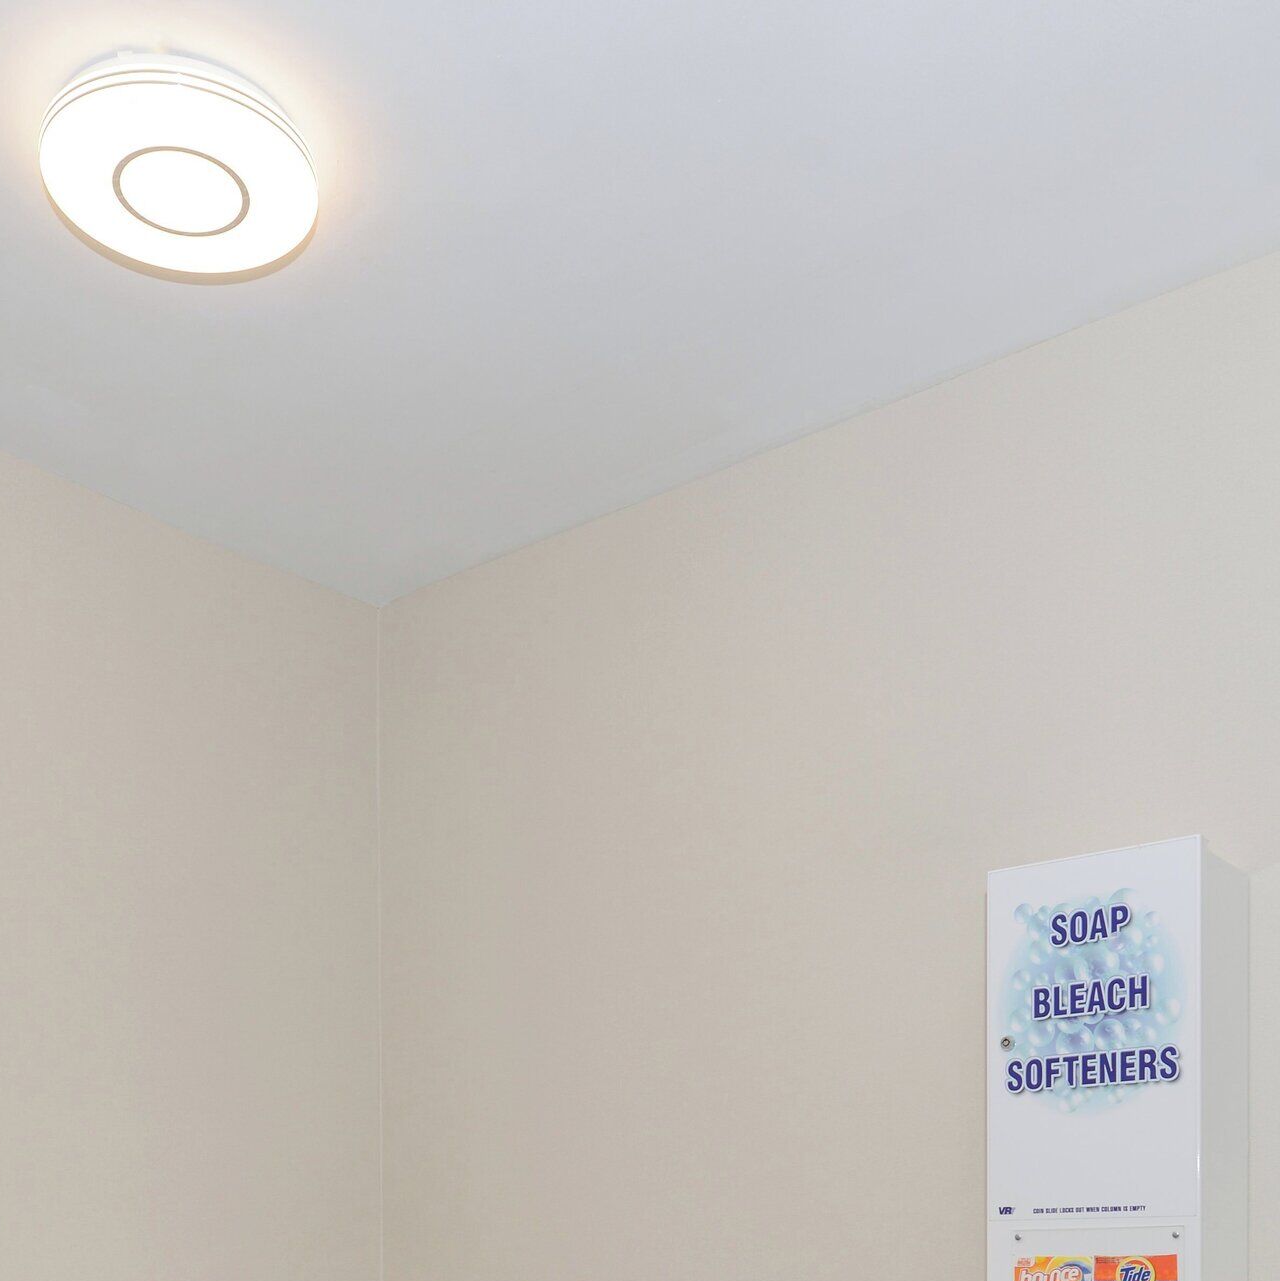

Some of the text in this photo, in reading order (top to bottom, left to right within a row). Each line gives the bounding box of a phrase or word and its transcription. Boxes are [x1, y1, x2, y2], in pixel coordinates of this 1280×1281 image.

[1050, 904, 1130, 946] SOAP
[1033, 974, 1148, 1020] BLEACH
[1007, 1045, 1179, 1092] SOFTENERS
